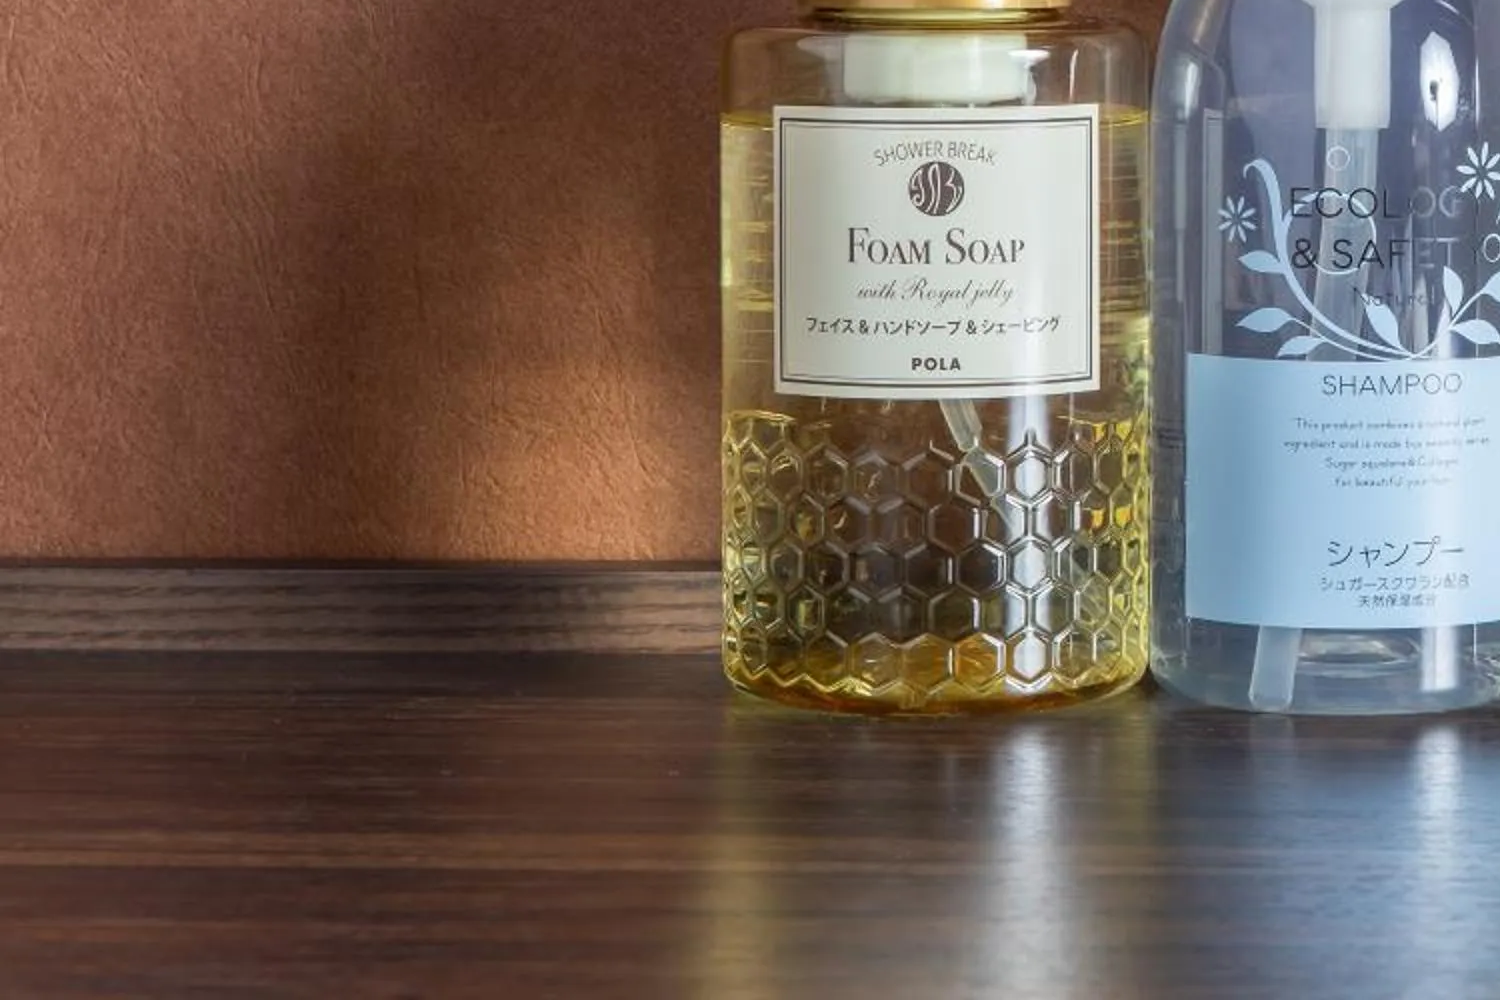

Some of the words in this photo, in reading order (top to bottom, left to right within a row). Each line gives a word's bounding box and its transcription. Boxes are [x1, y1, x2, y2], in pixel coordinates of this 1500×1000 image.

[873, 141, 943, 166] SHOWER
[948, 141, 996, 166] BREAK
[1291, 238, 1318, 270] &
[857, 279, 896, 300] with
[901, 276, 973, 308] Royal
[966, 279, 1016, 308] jelly
[911, 357, 962, 372] POLA
[1322, 373, 1463, 396] SHAMPOO
[1327, 536, 1464, 568] シャンプー
